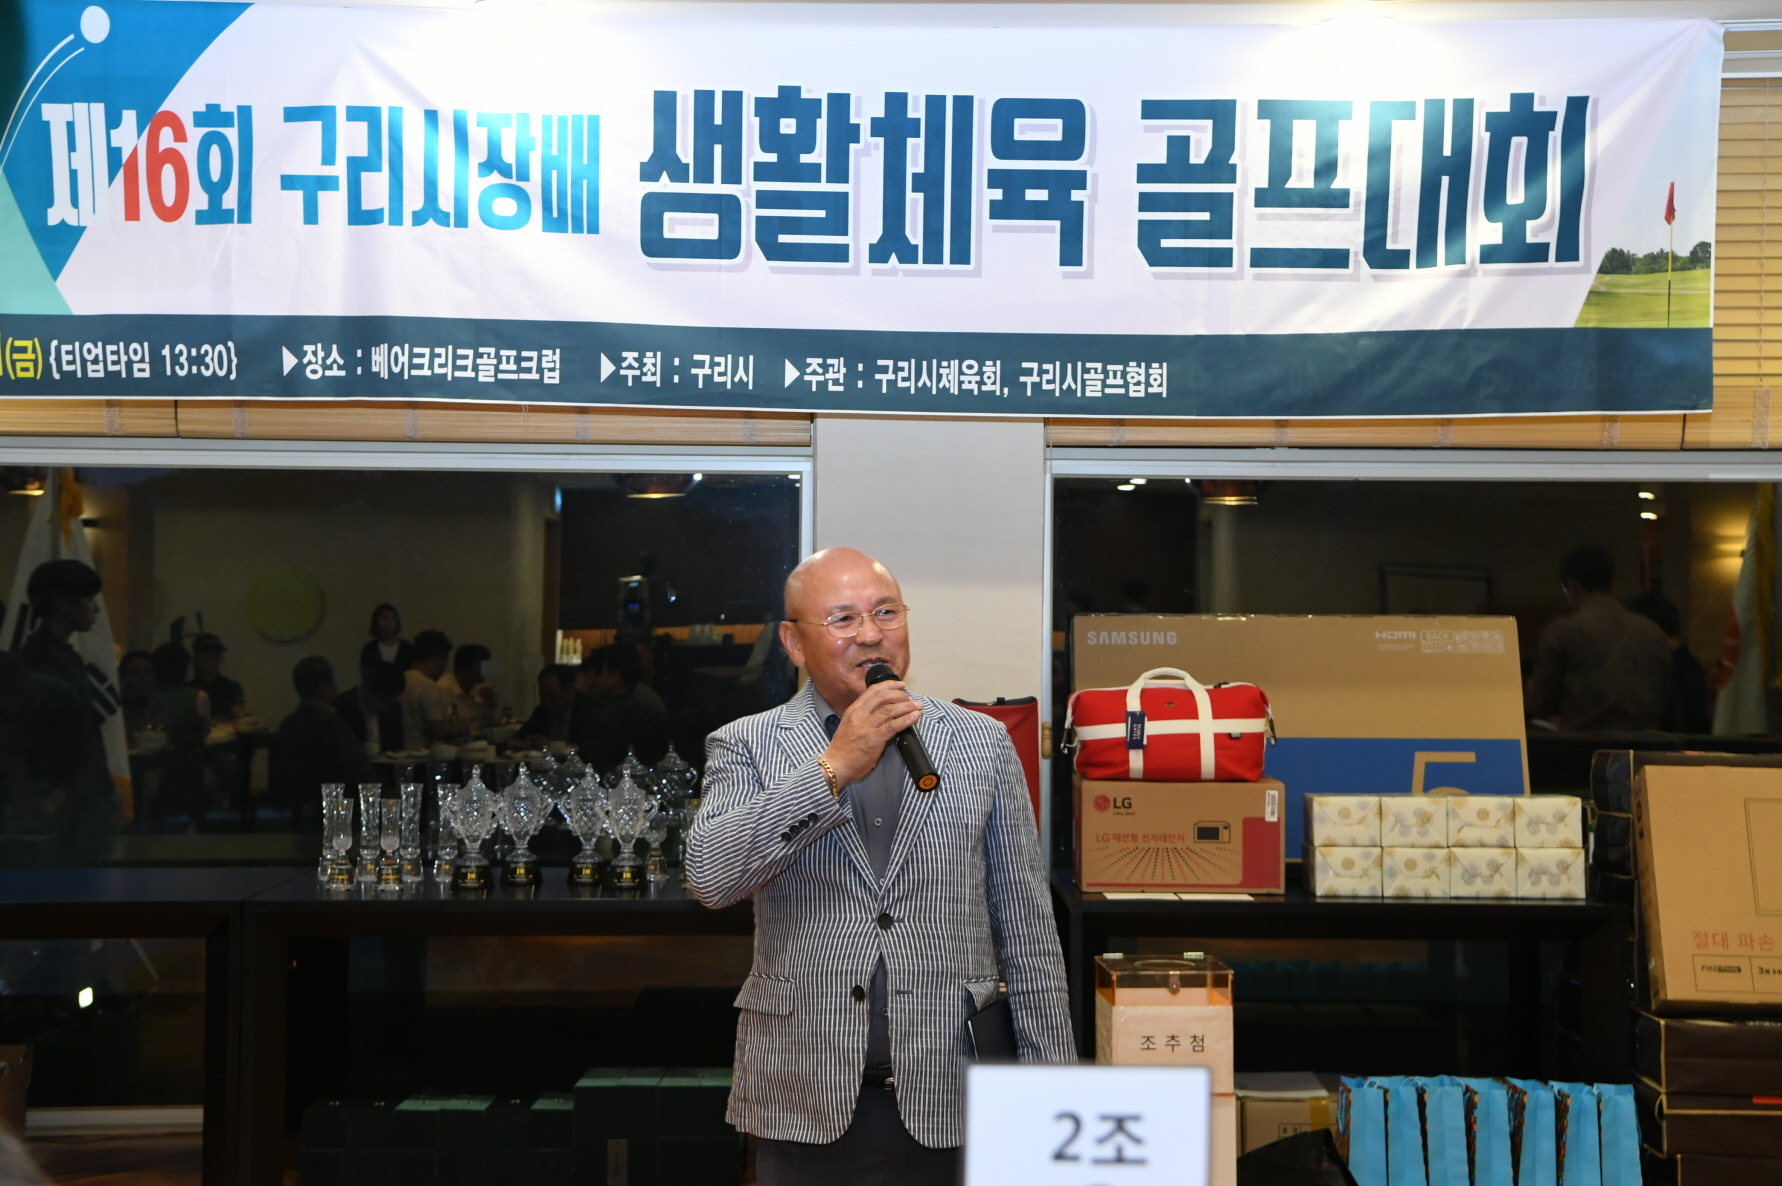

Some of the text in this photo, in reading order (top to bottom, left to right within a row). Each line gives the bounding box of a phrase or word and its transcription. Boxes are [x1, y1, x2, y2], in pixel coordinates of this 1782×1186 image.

[41, 84, 1590, 270] 제16회 구리시장배 생활체육 골프대회
[49, 339, 150, 380] {티업타임
[161, 341, 238, 380] 13:30}
[302, 343, 346, 379] 장소
[371, 344, 561, 384] 베어크리크골프크럽
[619, 351, 662, 387] 주최
[690, 354, 755, 389] 구리시
[803, 357, 847, 392] 주관
[874, 358, 1009, 398] 구리시체육회,
[1018, 361, 1168, 398] 구리시골프협회
[1087, 631, 1177, 645] SAMSUNG
[1375, 631, 1416, 639] HDMI
[1113, 797, 1132, 809] LG
[1096, 834, 1110, 843] LG
[1141, 833, 1185, 843] 전자레인지
[1692, 931, 1775, 951] 절대 파손
[1052, 1112, 1148, 1165] 2조
